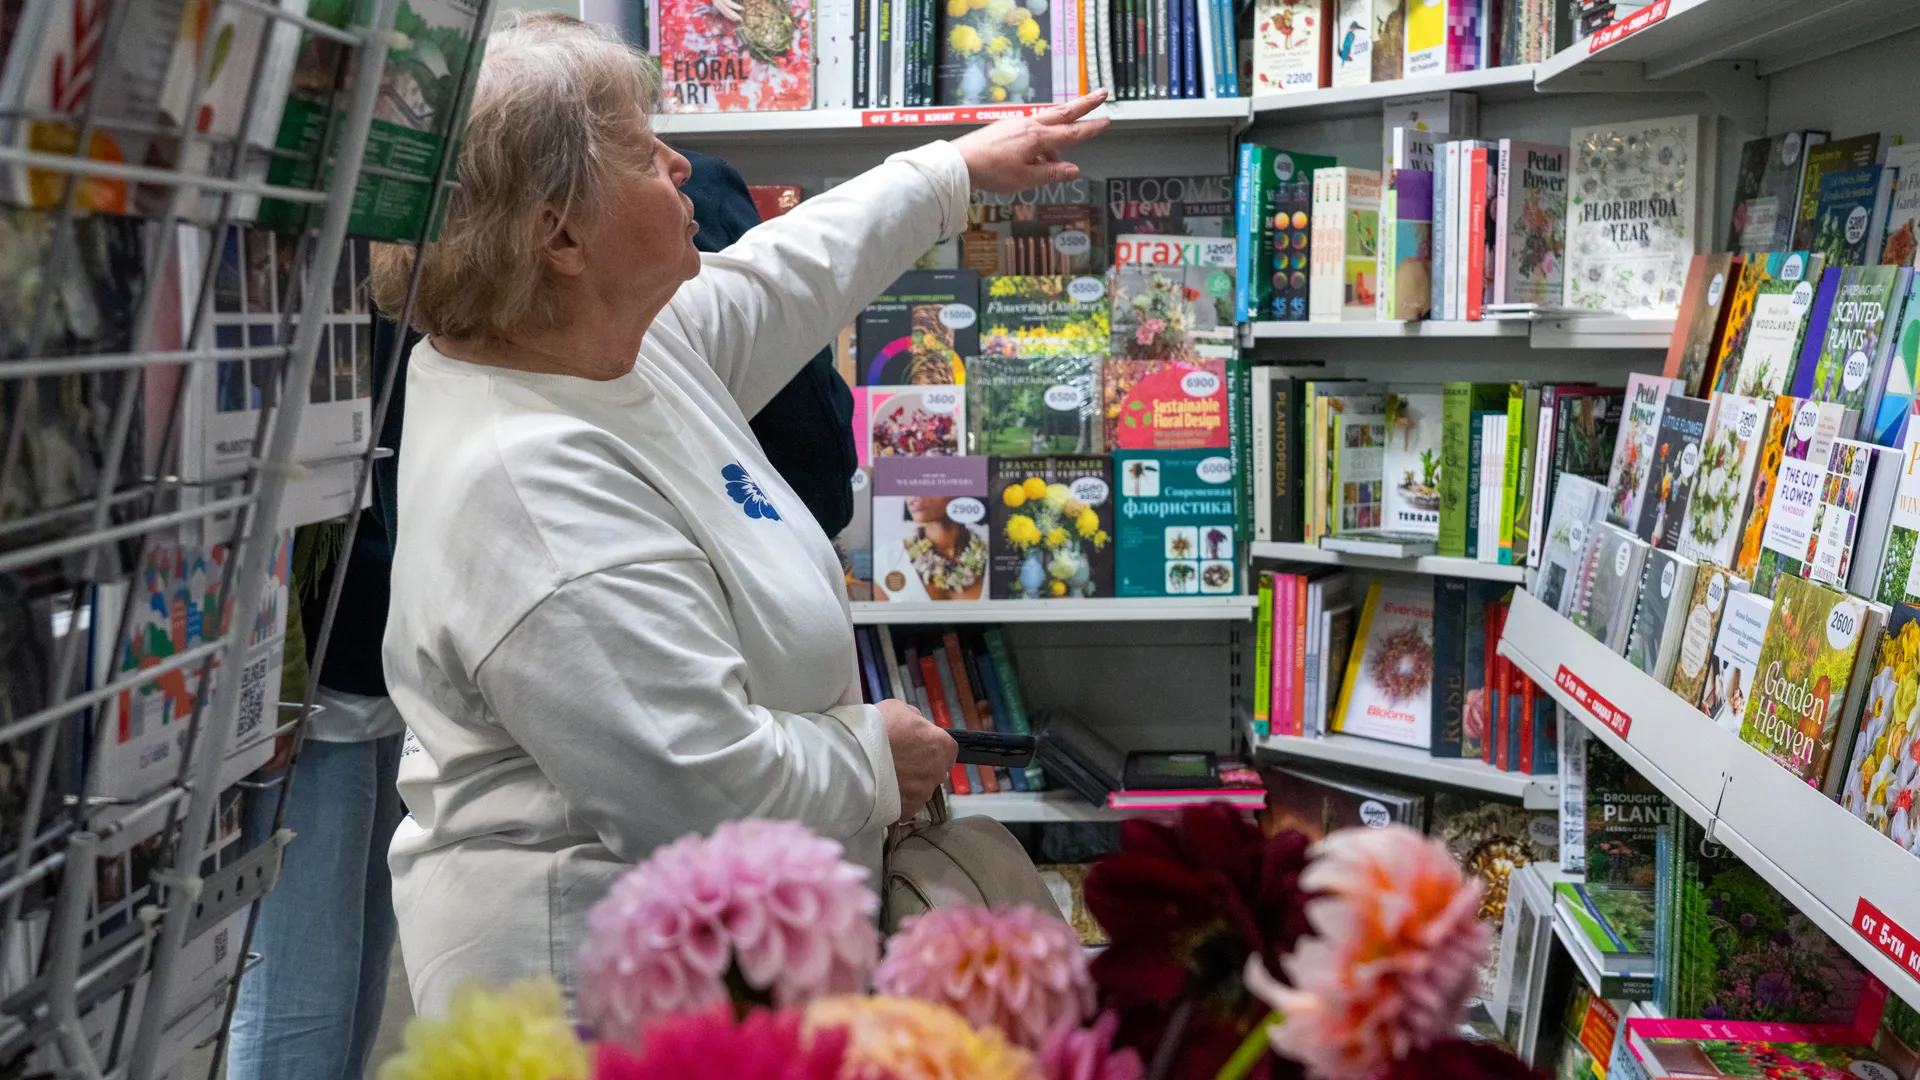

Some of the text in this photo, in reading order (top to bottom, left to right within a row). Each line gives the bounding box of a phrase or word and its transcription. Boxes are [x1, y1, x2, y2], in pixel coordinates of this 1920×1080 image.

[673, 58, 748, 81] FLORAL
[1286, 73, 1312, 84] 2200
[674, 82, 710, 104] ART
[870, 114, 886, 124] от
[892, 112, 919, 123] 5-ти
[924, 112, 956, 122] книг
[976, 110, 1023, 121] скидка
[1527, 150, 1562, 172] Petal
[1110, 177, 1233, 204] BLOOM'S
[1523, 170, 1565, 192] Power
[1110, 200, 1172, 220] View
[1584, 197, 1677, 222] FLORIBUNDA
[1609, 222, 1650, 242] YEAR
[1115, 241, 1210, 270] praxi
[1834, 302, 1882, 323] SCENTED
[1755, 319, 1796, 331] WOODLANDS
[1828, 329, 1867, 350] PLANTS
[1846, 363, 1865, 378] 5600
[1187, 377, 1215, 388] 6900
[928, 393, 955, 404] 3600
[1636, 383, 1659, 405] Petal
[1153, 398, 1220, 413] Sustainable
[1630, 403, 1656, 426] Power
[1153, 413, 1221, 430] Floral Design
[1799, 411, 1817, 427] 3500
[1275, 391, 1287, 498] PLANTOPEDIA
[999, 460, 1104, 469] FRANCES PALMER
[1202, 463, 1230, 473] 6000
[1785, 467, 1819, 489] THE CUT
[1164, 486, 1232, 498] Современная
[1781, 485, 1814, 508] FLOWER
[1123, 498, 1233, 519] флористика
[1782, 504, 1805, 518] HANDBOOK
[1899, 495, 1920, 514] WIN
[1398, 511, 1438, 523] TERRAR
[1383, 602, 1434, 617] Everlast
[1830, 611, 1854, 636] 2600
[1296, 625, 1304, 667] WREATHS
[1764, 661, 1824, 725] Garden
[1367, 705, 1416, 724] Blooms
[1440, 673, 1462, 744] ROSE
[1753, 696, 1815, 764] Heaven
[1603, 793, 1668, 804] DROUGHT-R
[1604, 804, 1671, 824] PLANT
